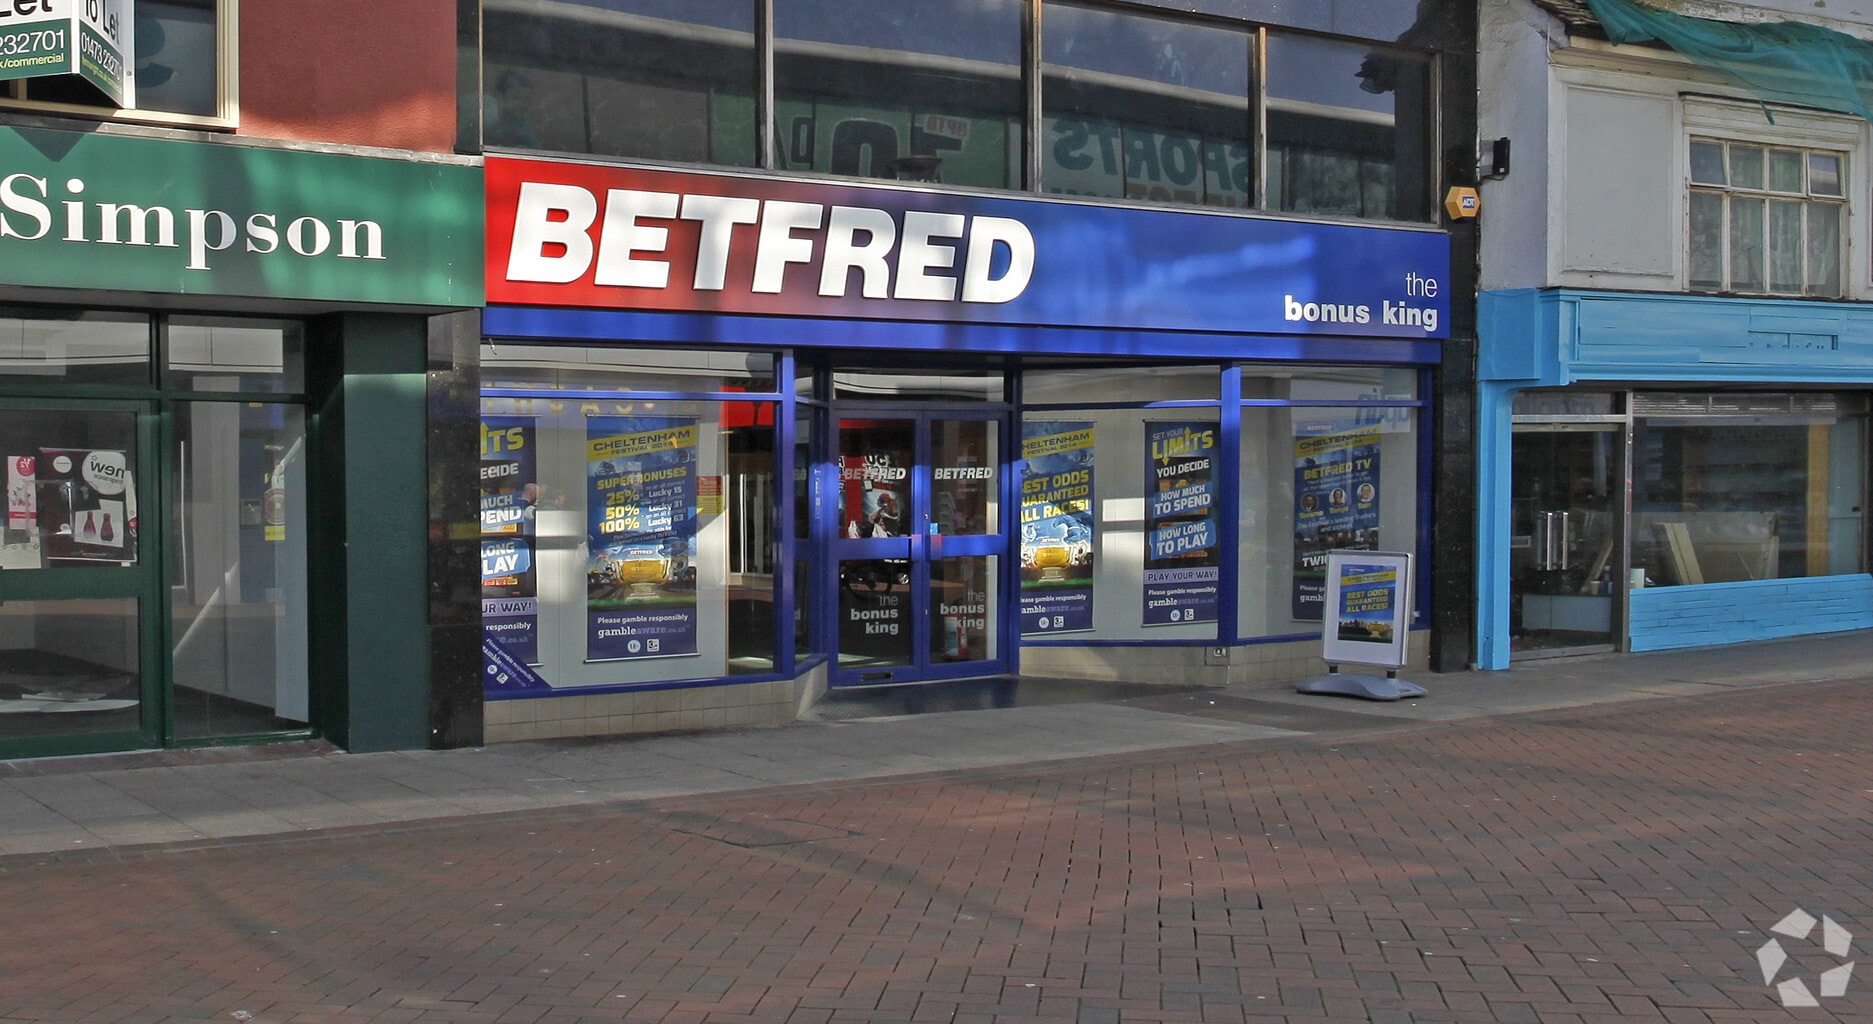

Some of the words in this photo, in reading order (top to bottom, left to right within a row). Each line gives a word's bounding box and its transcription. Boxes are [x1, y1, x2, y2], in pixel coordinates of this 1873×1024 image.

[0, 173, 387, 271] Simpson
[506, 181, 1036, 304] BETFRED
[1406, 272, 1437, 297] the
[1284, 295, 1370, 323] bonus
[1382, 300, 1438, 331] king
[1167, 428, 1184, 438] YOUR
[593, 430, 690, 451] CHELTENHAM
[1152, 428, 1214, 463] LIMITS
[611, 446, 648, 455] FESTIVAL
[1028, 446, 1056, 455] FESTIVAL
[1061, 442, 1077, 450] 2014
[845, 467, 907, 480] BETFRED
[934, 466, 994, 480] BETFRED
[1157, 465, 1176, 478] YOU
[1178, 459, 1210, 474] DECIDE
[1304, 462, 1353, 481] BETFRED
[1356, 458, 1372, 470] TV
[597, 474, 634, 490] SUPER
[1022, 478, 1049, 493] EST
[1053, 469, 1089, 488] ODDS
[606, 489, 640, 507] 25%
[649, 488, 672, 498] Lucky
[674, 485, 682, 494] 15
[1161, 489, 1180, 502] HOW
[1182, 484, 1205, 495] MUCH
[648, 502, 672, 512] Lucky
[1043, 499, 1090, 519] RACES!
[1155, 501, 1172, 515] TO
[1173, 493, 1211, 512] SPEND
[605, 504, 640, 520] 50%
[598, 517, 640, 535] 100%
[647, 517, 672, 527] Lucky
[1160, 527, 1181, 541] HOW
[1183, 522, 1206, 535] LONG
[1157, 540, 1174, 556] TO
[1177, 532, 1208, 551] PLAY
[1148, 573, 1170, 581] PLAY
[1172, 571, 1193, 580] YOUR
[967, 590, 986, 602] the
[1186, 586, 1216, 594] responsibly
[1346, 591, 1365, 599] BEST
[1367, 589, 1389, 597] ODDS
[877, 595, 899, 607] the
[1035, 595, 1054, 604] gamble
[1055, 594, 1086, 602] responsibly
[501, 602, 531, 613] WAY!
[850, 608, 899, 620] bonus
[940, 603, 985, 615] bonus
[622, 616, 647, 624] gamble
[648, 614, 688, 622] responsibly
[957, 616, 985, 630] king
[486, 622, 531, 631] responsibly
[865, 621, 899, 636] king
